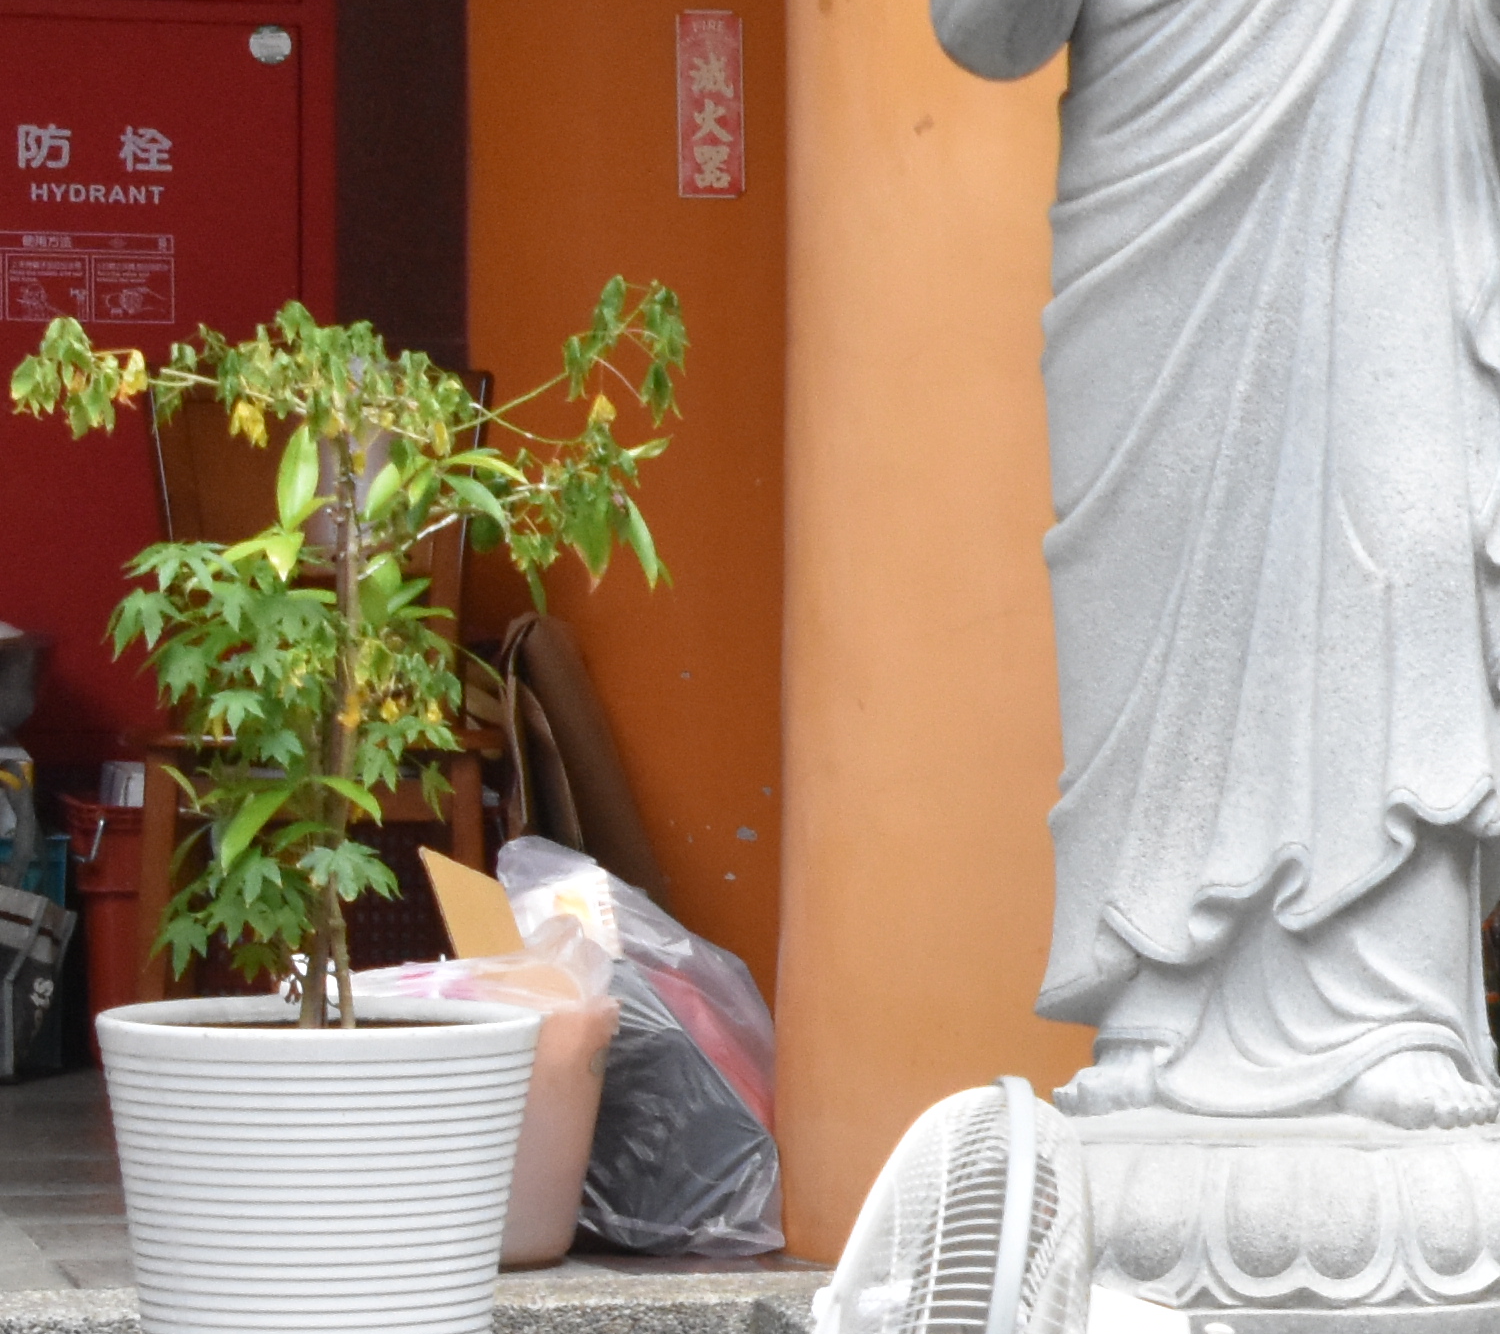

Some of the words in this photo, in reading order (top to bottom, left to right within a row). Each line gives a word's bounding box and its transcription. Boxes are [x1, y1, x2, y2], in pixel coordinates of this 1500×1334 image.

[690, 52, 735, 189] 滅火器
[17, 123, 173, 172] 防栓
[30, 182, 165, 205] HYDRANT
